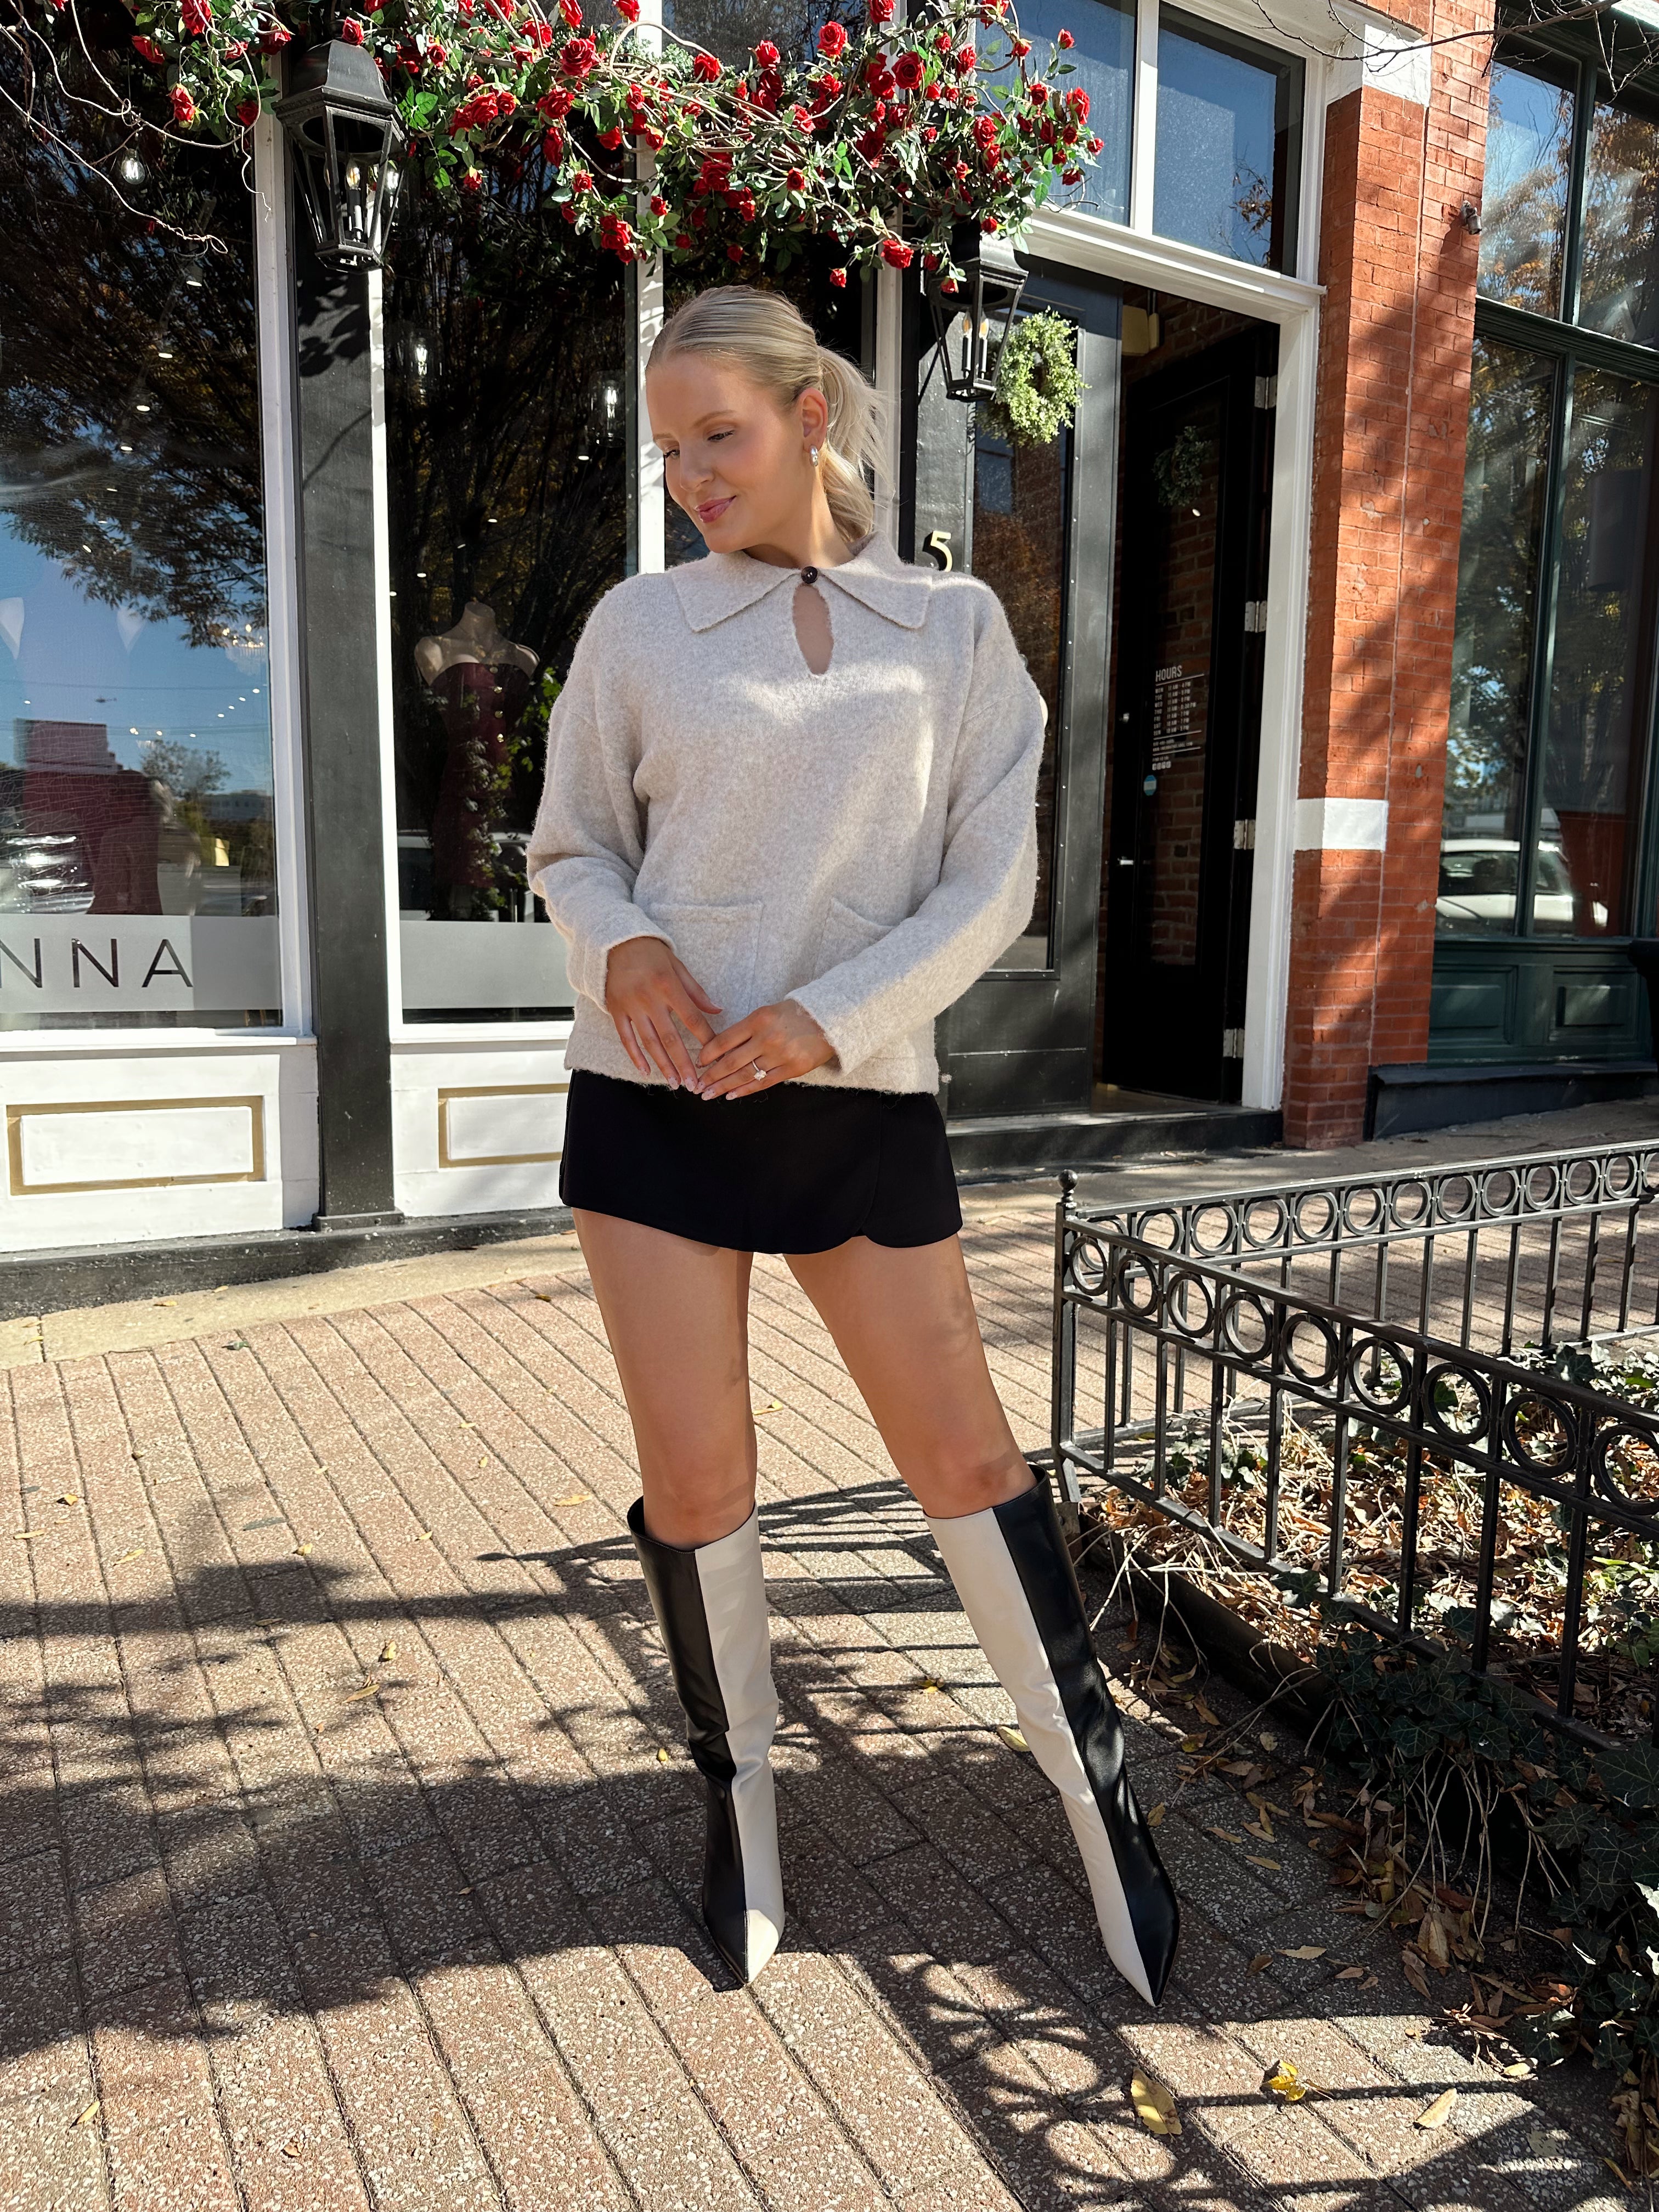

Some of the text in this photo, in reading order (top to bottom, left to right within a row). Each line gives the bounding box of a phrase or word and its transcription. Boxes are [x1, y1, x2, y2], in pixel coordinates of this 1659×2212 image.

[930, 531, 952, 572] 5
[1155, 665, 1182, 682] HOURS
[0, 938, 193, 988] NNA
